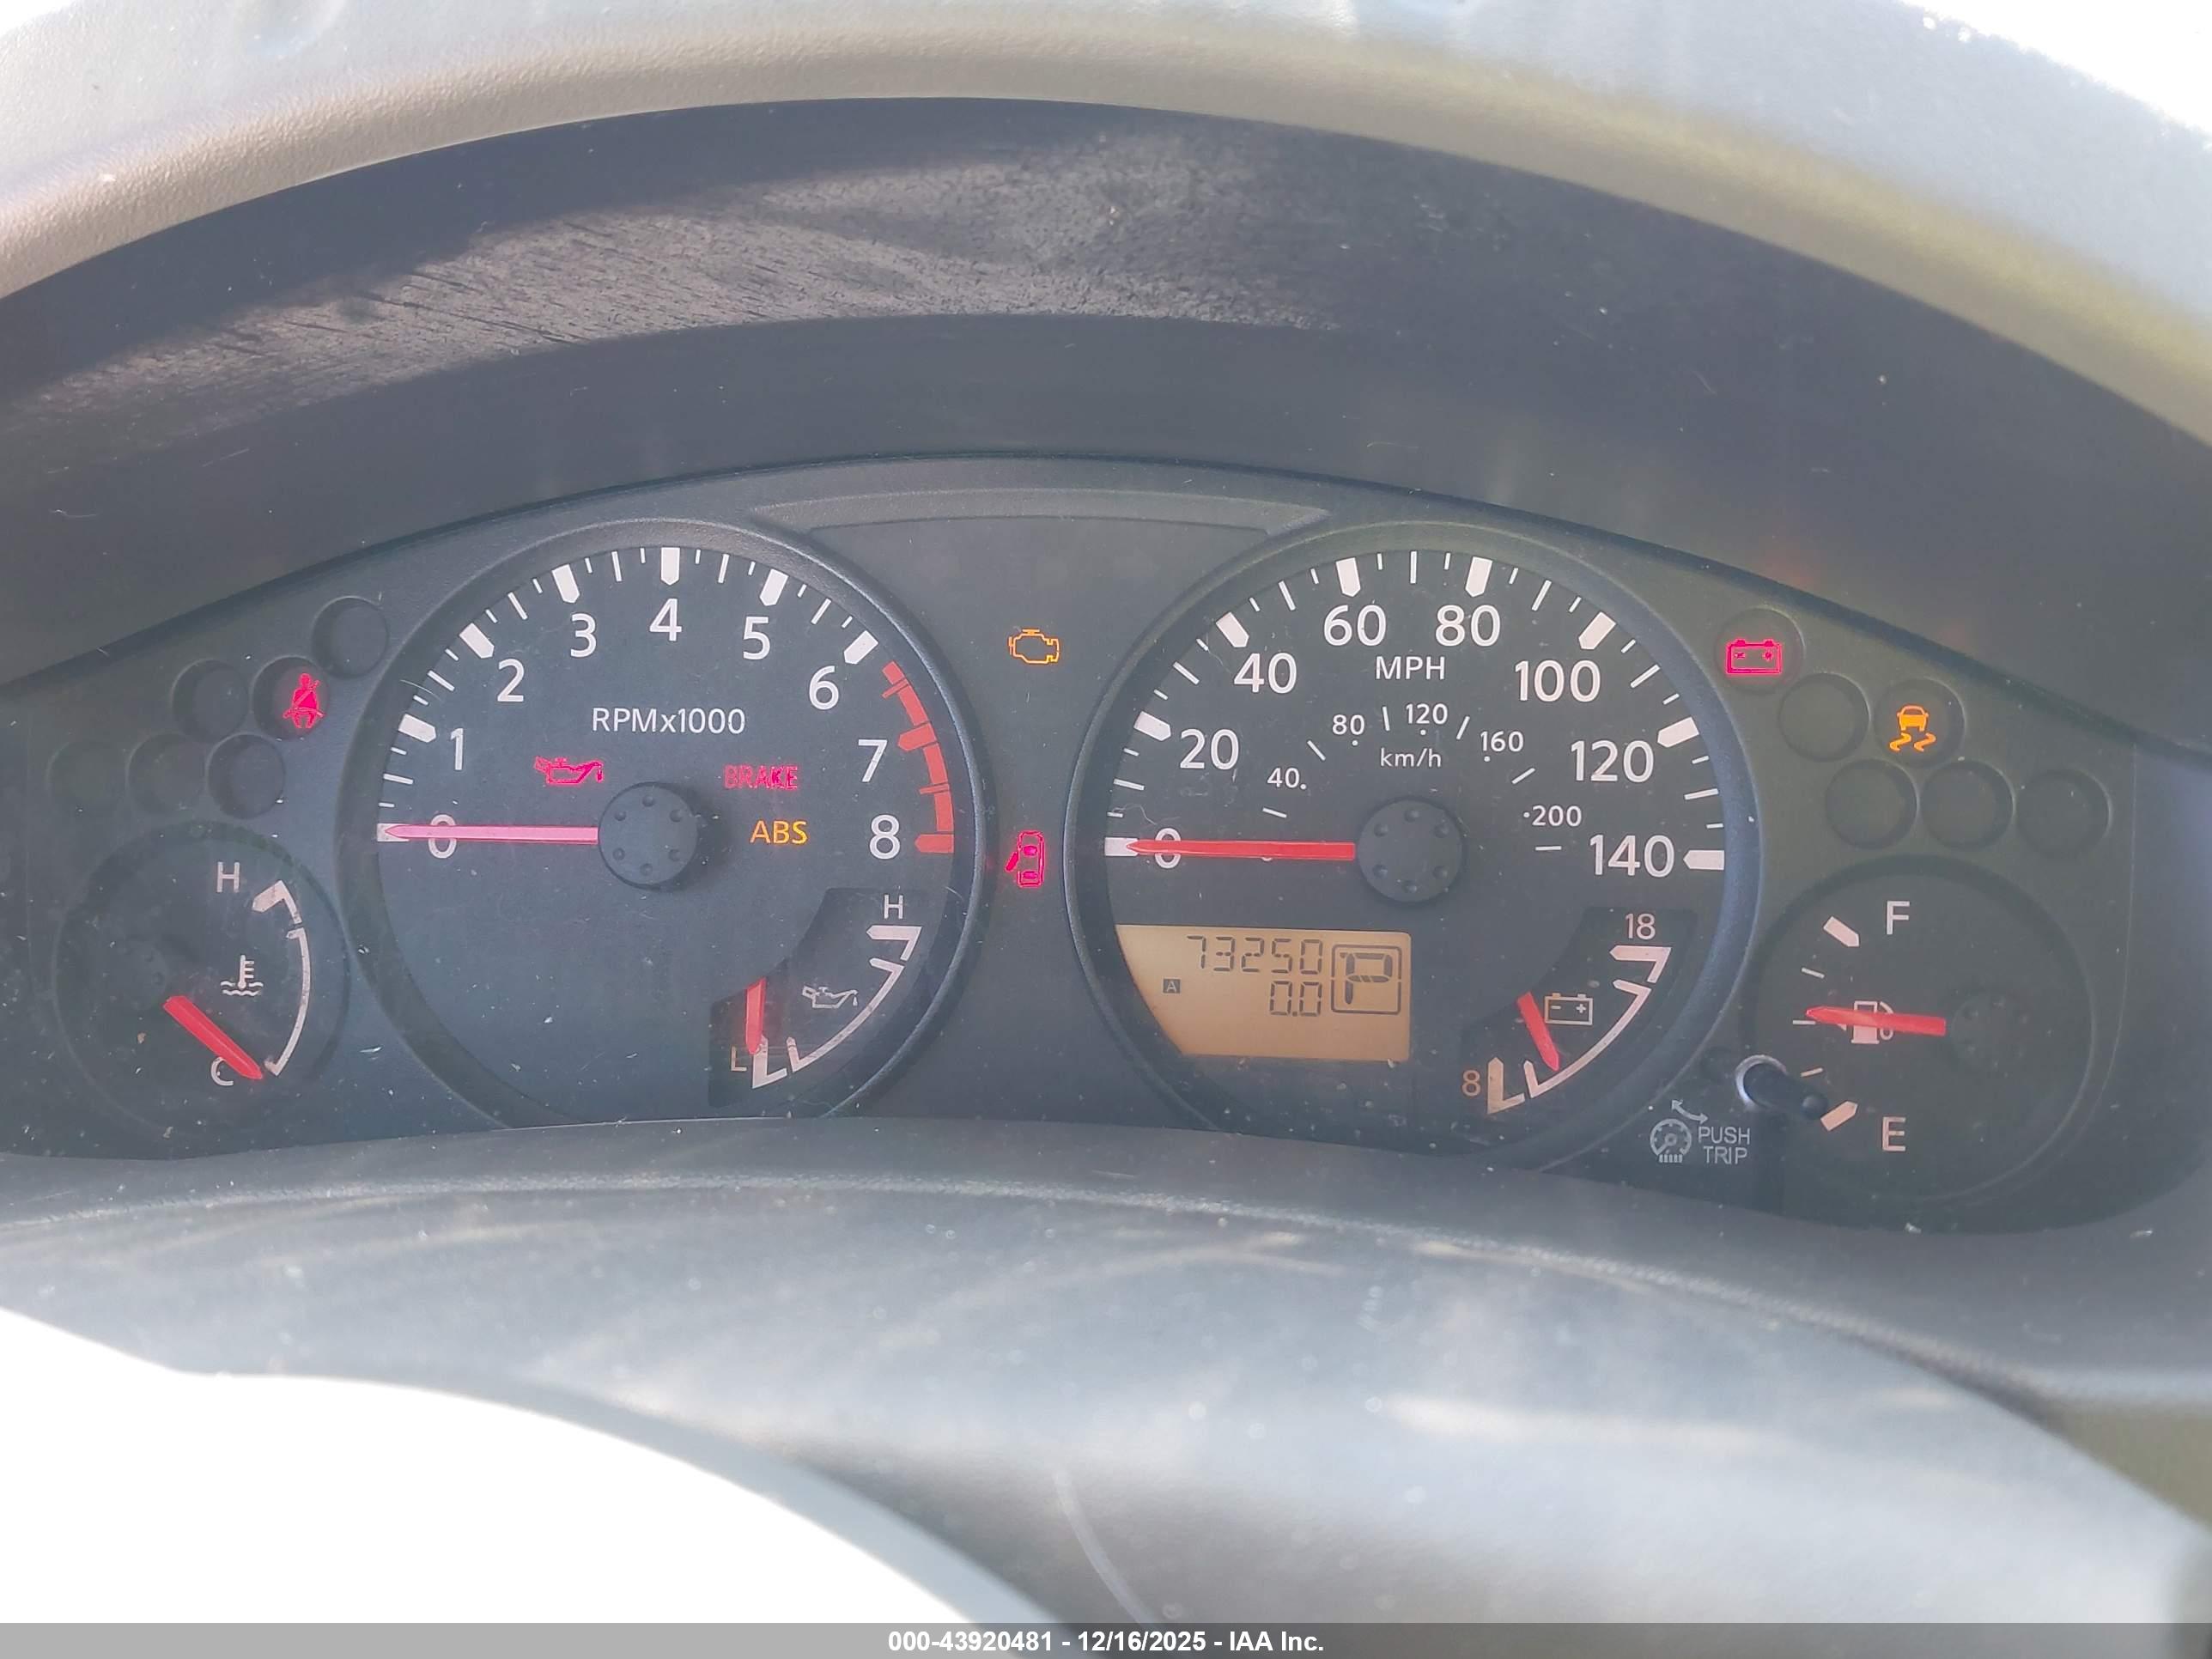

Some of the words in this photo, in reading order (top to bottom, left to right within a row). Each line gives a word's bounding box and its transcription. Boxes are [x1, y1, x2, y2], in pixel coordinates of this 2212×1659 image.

[570, 614, 596, 657] 3
[650, 599, 682, 641] 4
[744, 617, 771, 659] 5
[1323, 605, 1386, 646] 60
[1436, 606, 1501, 647] 80
[497, 660, 524, 702] 2
[809, 666, 840, 709] 6
[1233, 653, 1297, 694] 40
[1376, 657, 1446, 681] MPH
[1515, 660, 1601, 702] 100
[592, 708, 745, 732] RPMx1000
[1333, 714, 1365, 736] 80
[1406, 704, 1448, 725] 120
[450, 729, 463, 769] 1
[858, 739, 887, 781] 7
[1179, 729, 1239, 769] 20
[1380, 748, 1442, 769] km/h
[1481, 731, 1523, 752] 160
[724, 766, 798, 790] BRAKE
[1267, 768, 1301, 788] 40
[1571, 740, 1655, 783] 120
[750, 820, 808, 845] ABS
[1531, 805, 1582, 827] 200
[428, 815, 457, 859] 0
[869, 816, 900, 859] 8
[1154, 828, 1182, 868] 0
[1590, 835, 1674, 877] 140
[216, 861, 240, 893] H
[884, 895, 904, 919] H
[1887, 901, 1910, 935] F
[1626, 915, 1656, 939] 18
[1187, 934, 1323, 974] 73250
[1339, 952, 1394, 1006] P
[1268, 980, 1322, 1018] 0.0
[732, 1048, 746, 1072] L
[1462, 1070, 1480, 1097] 8
[1698, 1126, 1751, 1145] PUSH
[1882, 1117, 1906, 1152] E
[1704, 1146, 1748, 1164] TRIP
